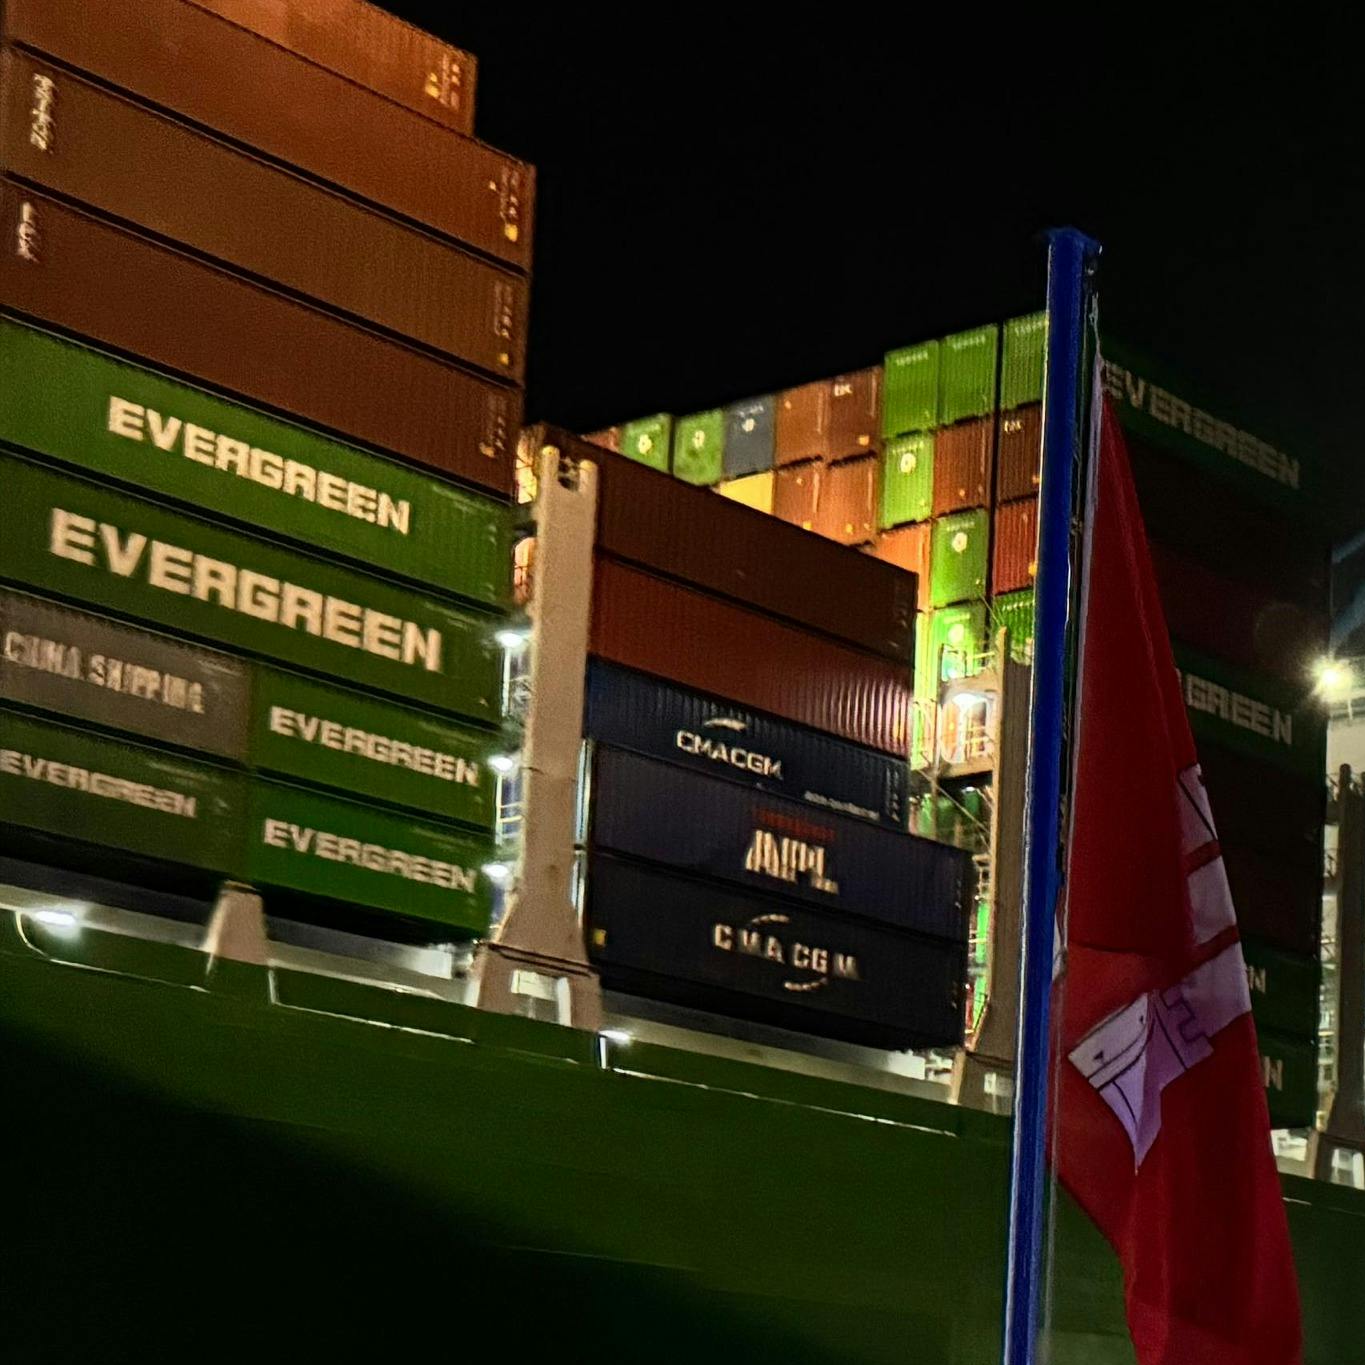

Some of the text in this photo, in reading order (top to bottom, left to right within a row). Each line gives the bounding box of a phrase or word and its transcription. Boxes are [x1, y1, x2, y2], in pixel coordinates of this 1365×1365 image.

[1101, 357, 1301, 490] EVERGREEN
[107, 396, 411, 536] EVERGREEN
[49, 507, 444, 673] EVERGREEN
[4, 631, 206, 715] CHINA SHIPPING
[0, 749, 198, 819] EVERGREEN
[269, 705, 480, 787] EVERGREEN
[263, 817, 477, 895] EVERGREEN
